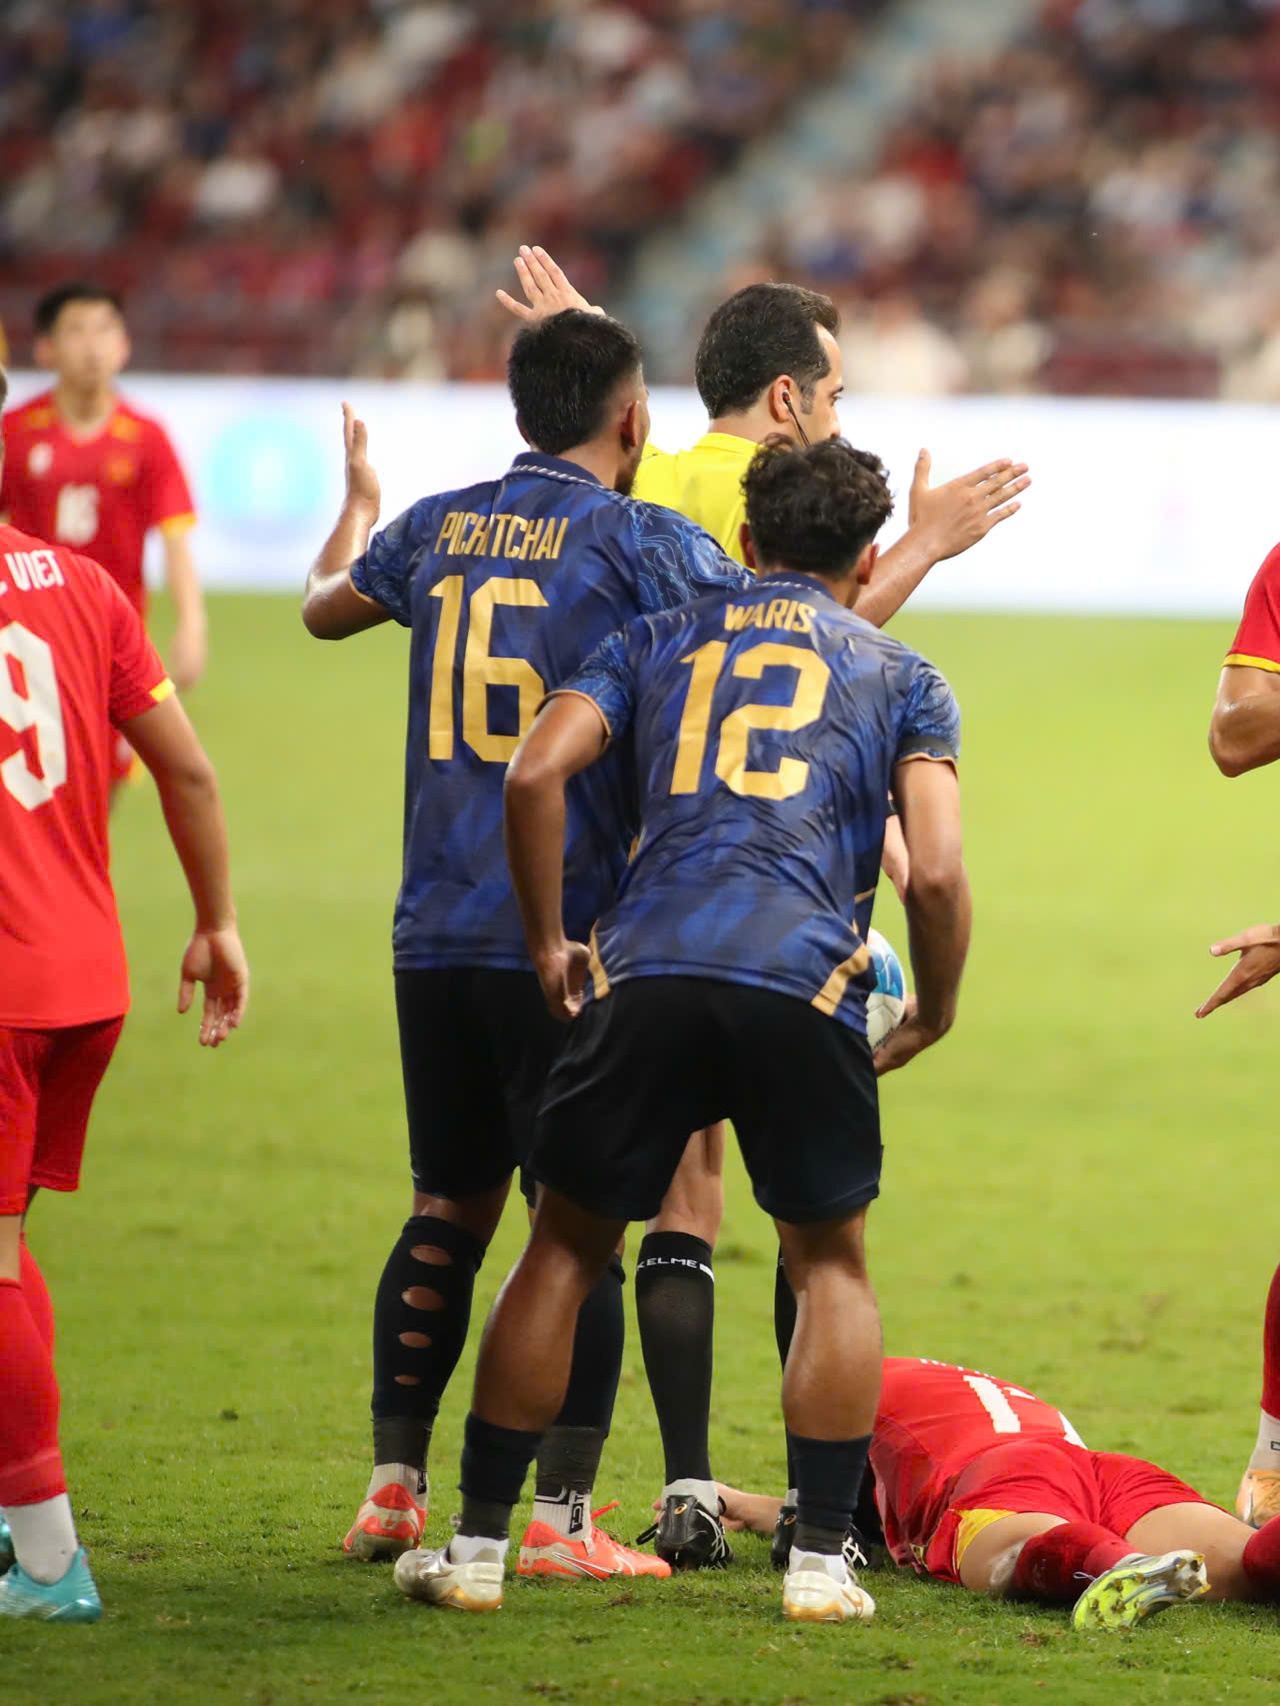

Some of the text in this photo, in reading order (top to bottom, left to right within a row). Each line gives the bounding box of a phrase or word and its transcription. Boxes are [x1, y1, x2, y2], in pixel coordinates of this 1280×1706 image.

[428, 574, 549, 762] 16
[724, 598, 817, 633] WARIS
[669, 640, 832, 801] 12
